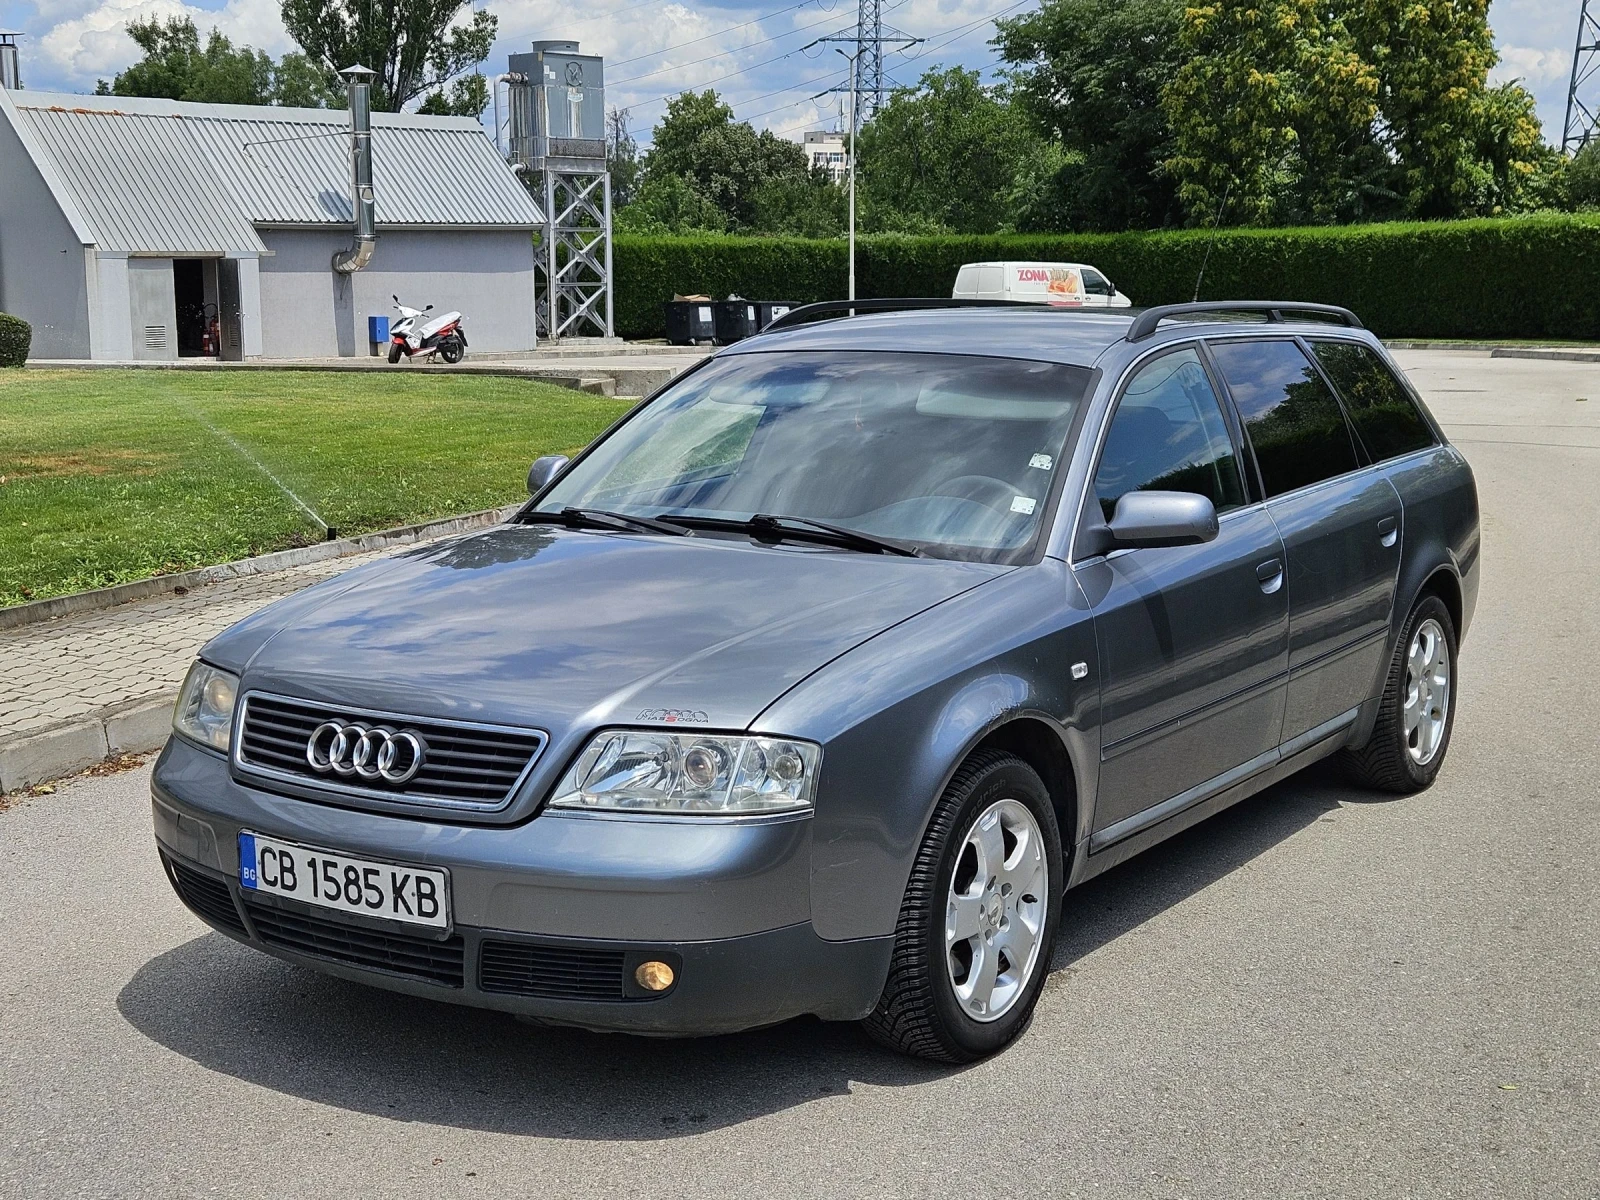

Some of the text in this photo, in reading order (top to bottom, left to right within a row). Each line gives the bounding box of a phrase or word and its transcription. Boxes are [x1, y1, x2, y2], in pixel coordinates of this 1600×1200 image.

[1017, 269, 1050, 282] ZONA
[243, 866, 256, 881] BG
[260, 846, 439, 919] CB 1585 KB
